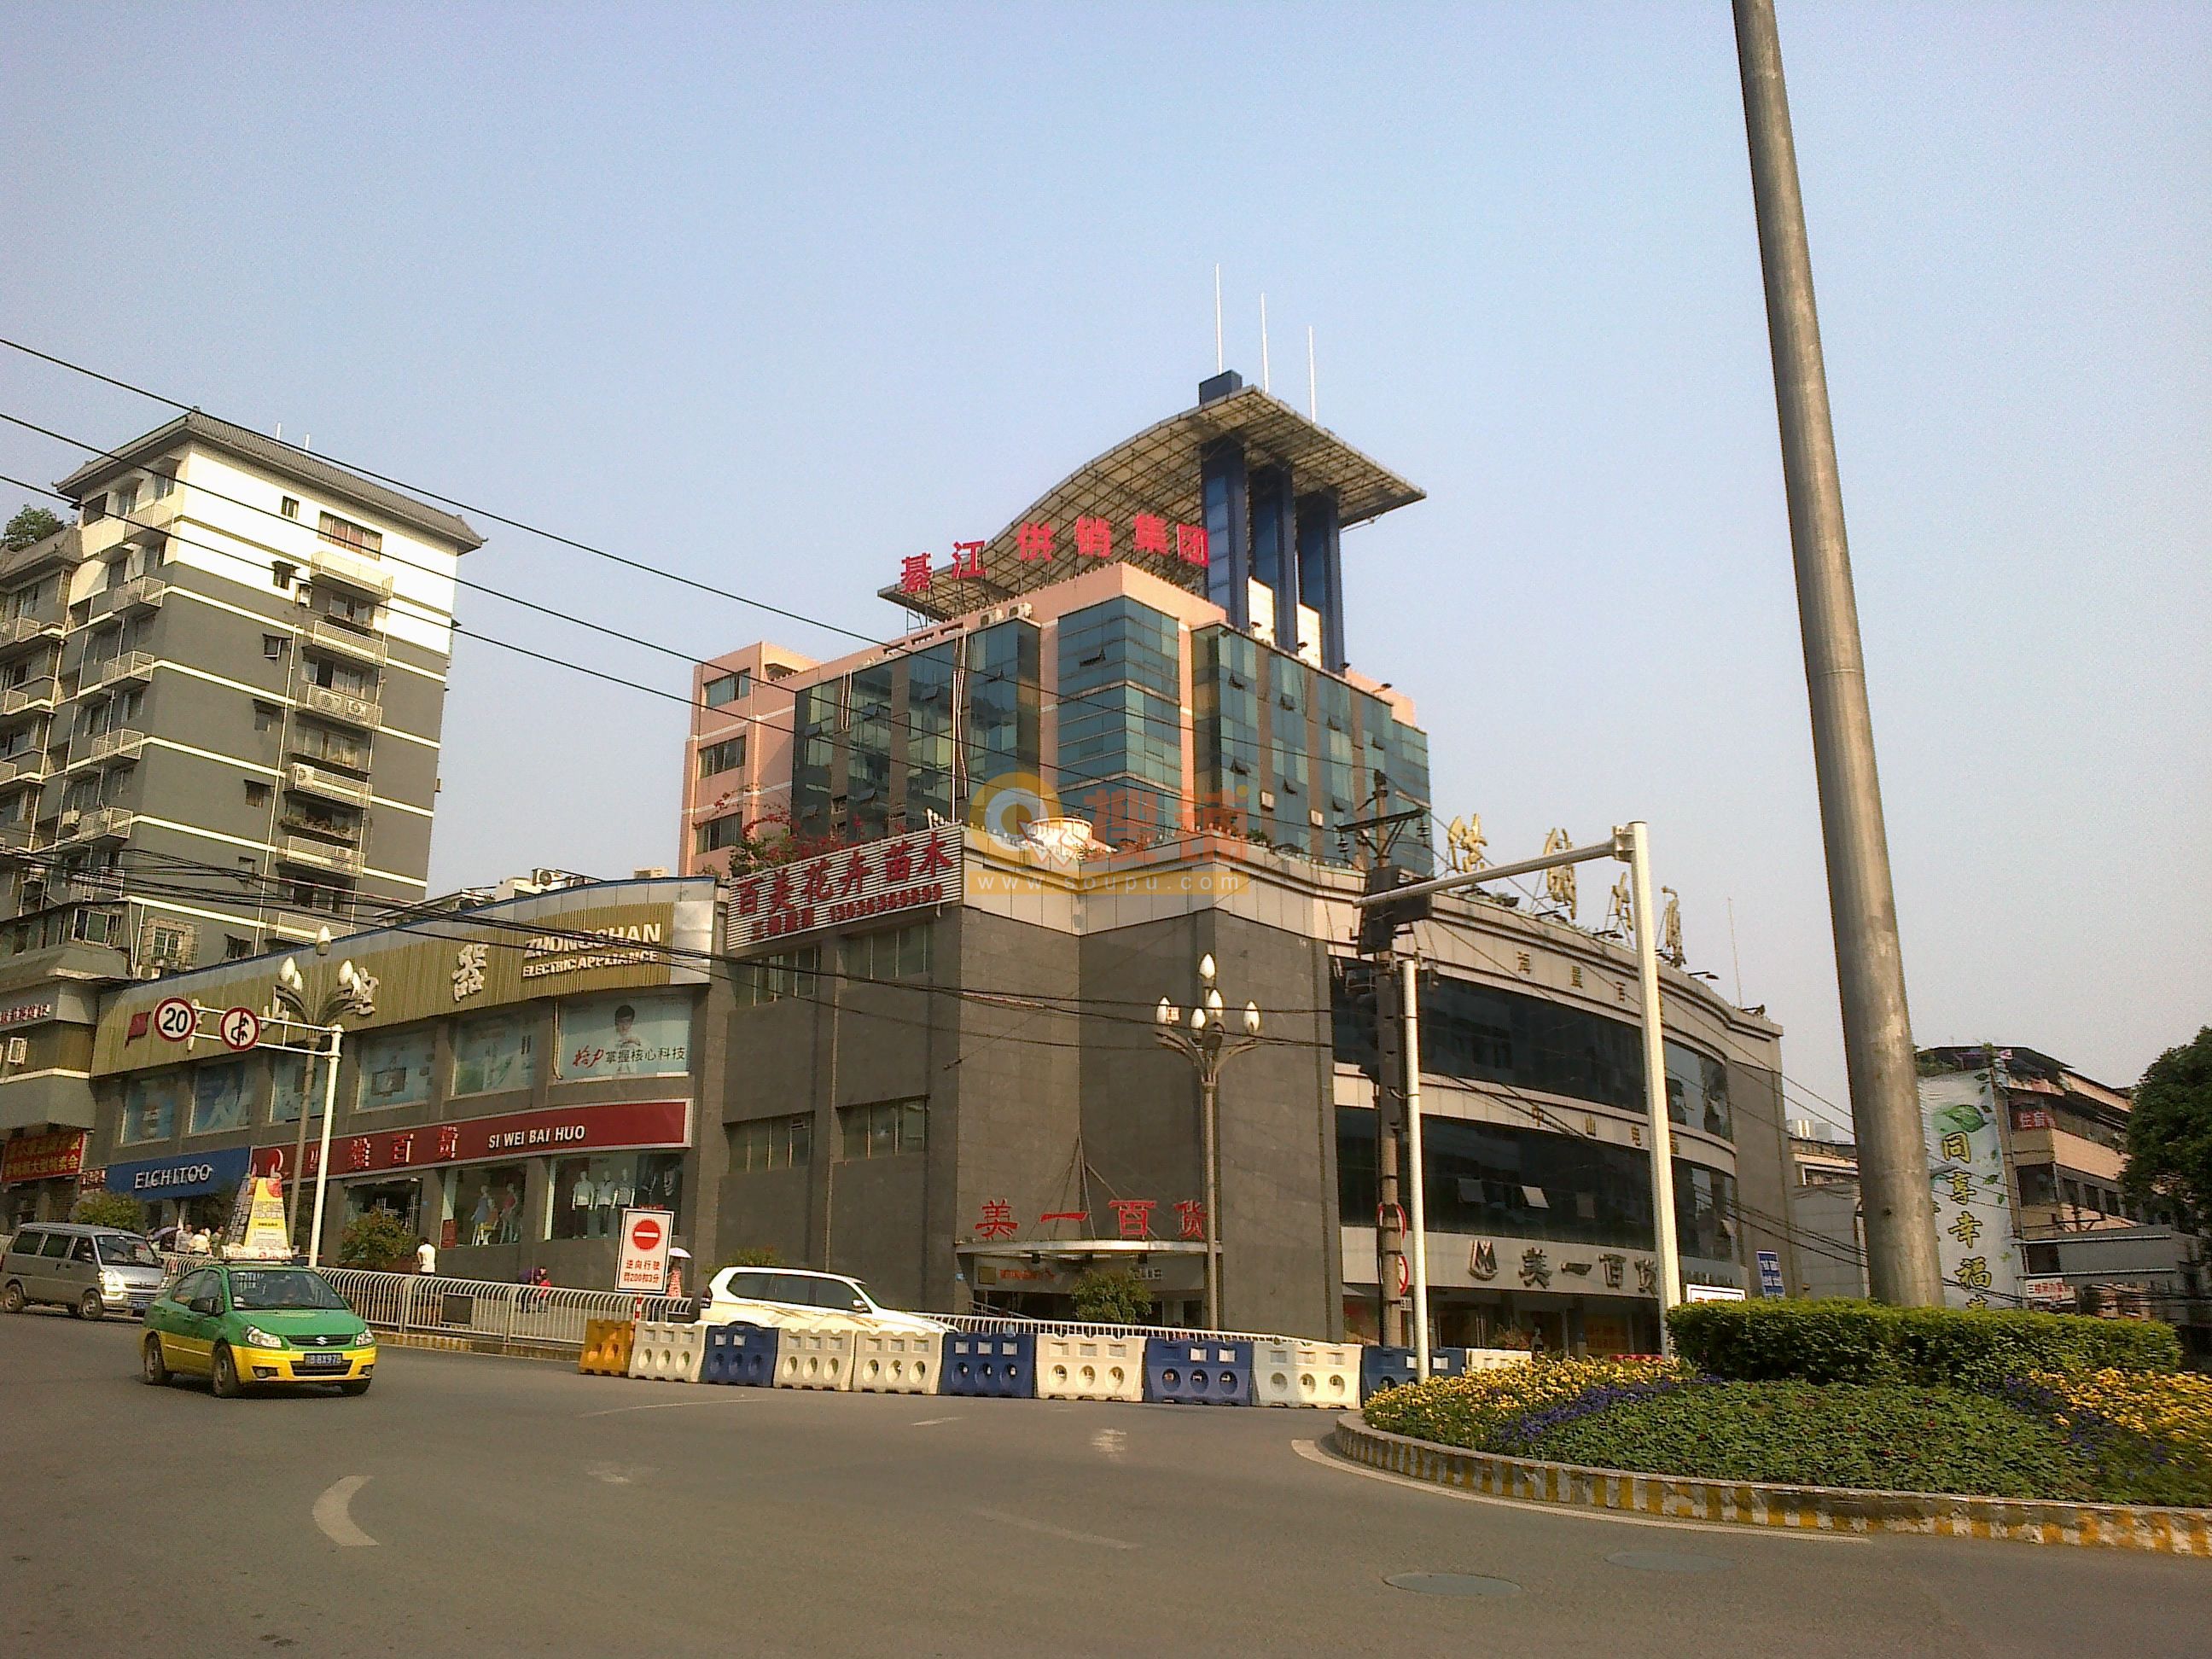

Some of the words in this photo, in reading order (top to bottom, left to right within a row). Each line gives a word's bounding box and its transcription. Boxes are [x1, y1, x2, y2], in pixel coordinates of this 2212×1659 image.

[900, 513, 1209, 594] 綦江供销集团
[522, 958, 576, 977] ELECTRIC
[163, 1007, 188, 1033] 20
[605, 1046, 686, 1064] 掌握核心科技
[488, 1134, 500, 1150] SI
[504, 1131, 526, 1148] WEI
[529, 1129, 550, 1145] BAI
[555, 1125, 586, 1141] HUO
[975, 1198, 1208, 1238] 美一百货
[626, 1259, 661, 1271] 逆向行驶
[1518, 1247, 1658, 1295] 美一百货
